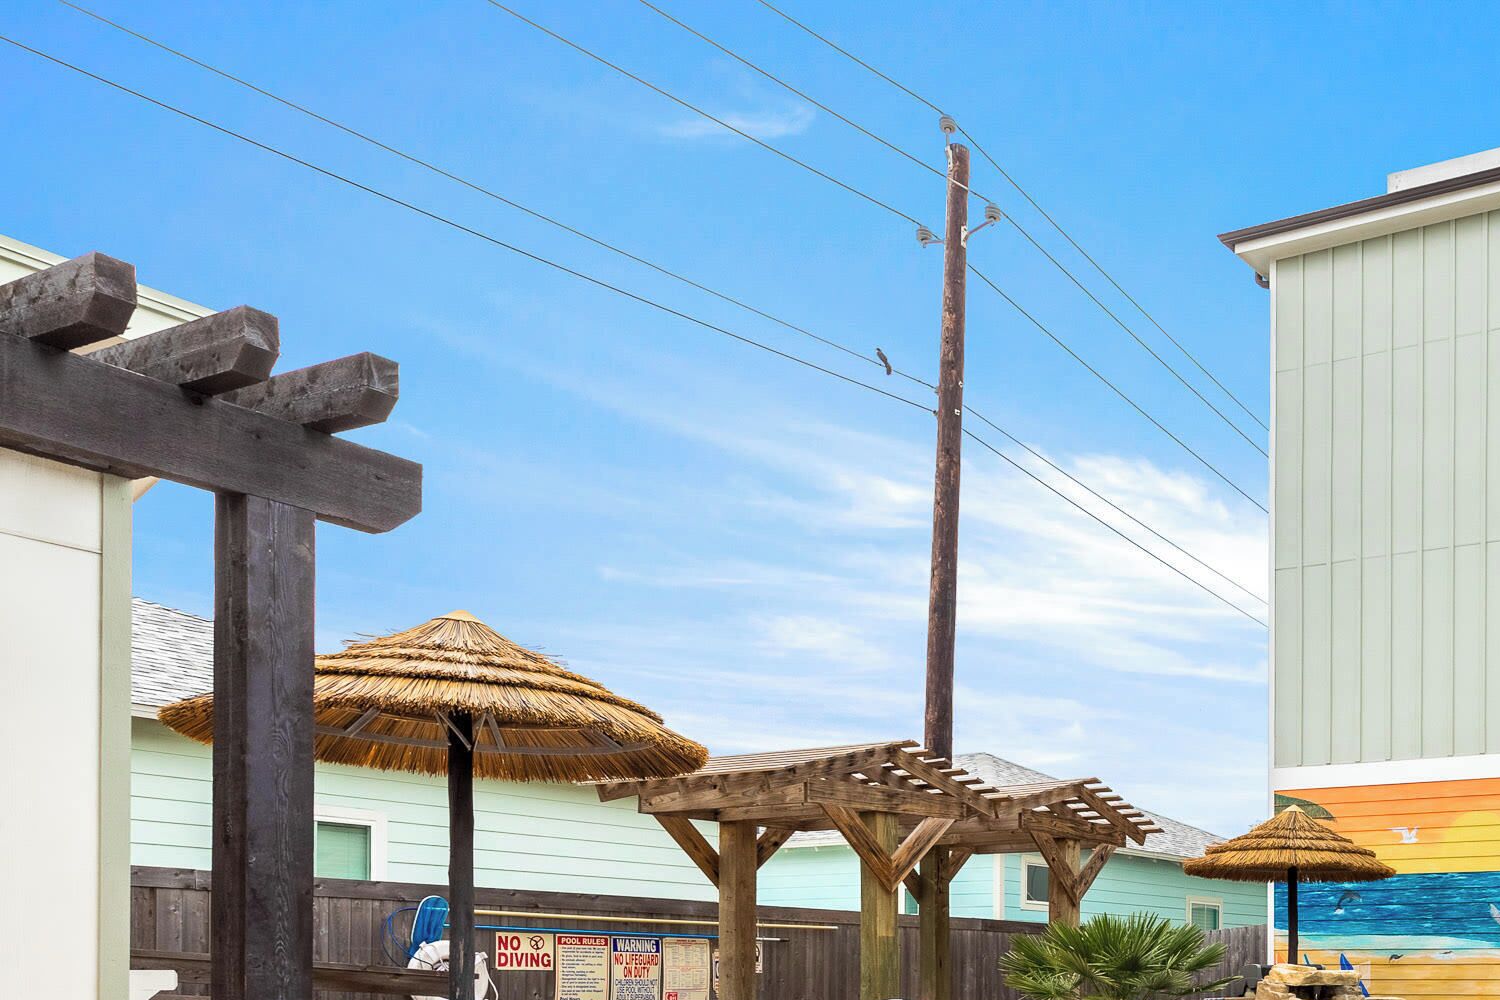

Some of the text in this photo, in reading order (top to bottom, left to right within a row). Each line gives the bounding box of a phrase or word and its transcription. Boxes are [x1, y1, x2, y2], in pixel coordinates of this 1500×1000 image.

[497, 935, 521, 951] NO
[561, 937, 606, 946] POOL RULES
[616, 938, 657, 952] WARNING
[497, 952, 552, 968] DIVING
[614, 953, 624, 965] NO
[625, 953, 659, 966] LIFEGUARD
[623, 966, 650, 978] ON DUTY
[615, 978, 634, 986] CHILDREN
[637, 986, 655, 994] WITHOUT
[616, 993, 655, 1000] ADULT SUPERVISION
